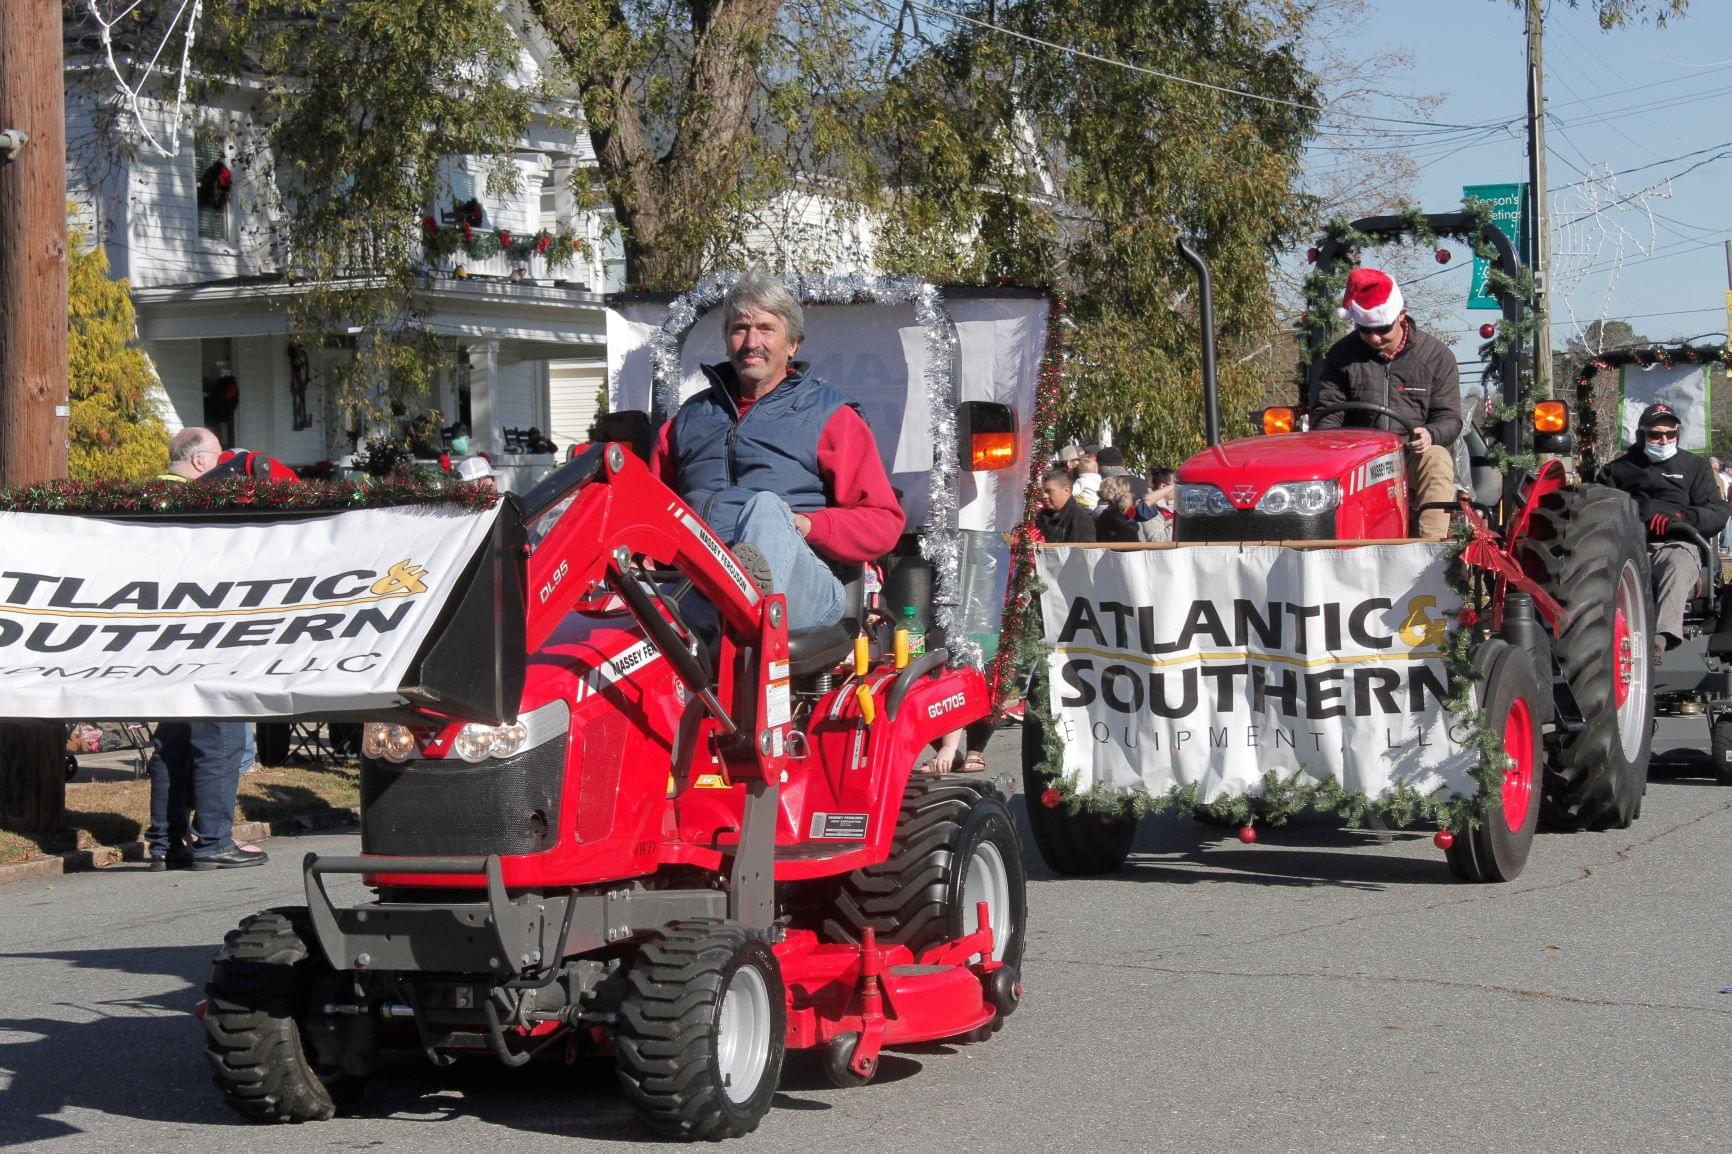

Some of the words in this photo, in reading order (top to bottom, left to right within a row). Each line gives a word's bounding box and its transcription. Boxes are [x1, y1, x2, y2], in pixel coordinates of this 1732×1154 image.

[540, 559, 568, 604] DL95
[700, 529, 721, 558] MASSEY
[721, 554, 747, 592] FERGUSON
[265, 652, 382, 675] LLC
[612, 649, 642, 676] MASSEY
[1061, 659, 1452, 719] SOUTHERN
